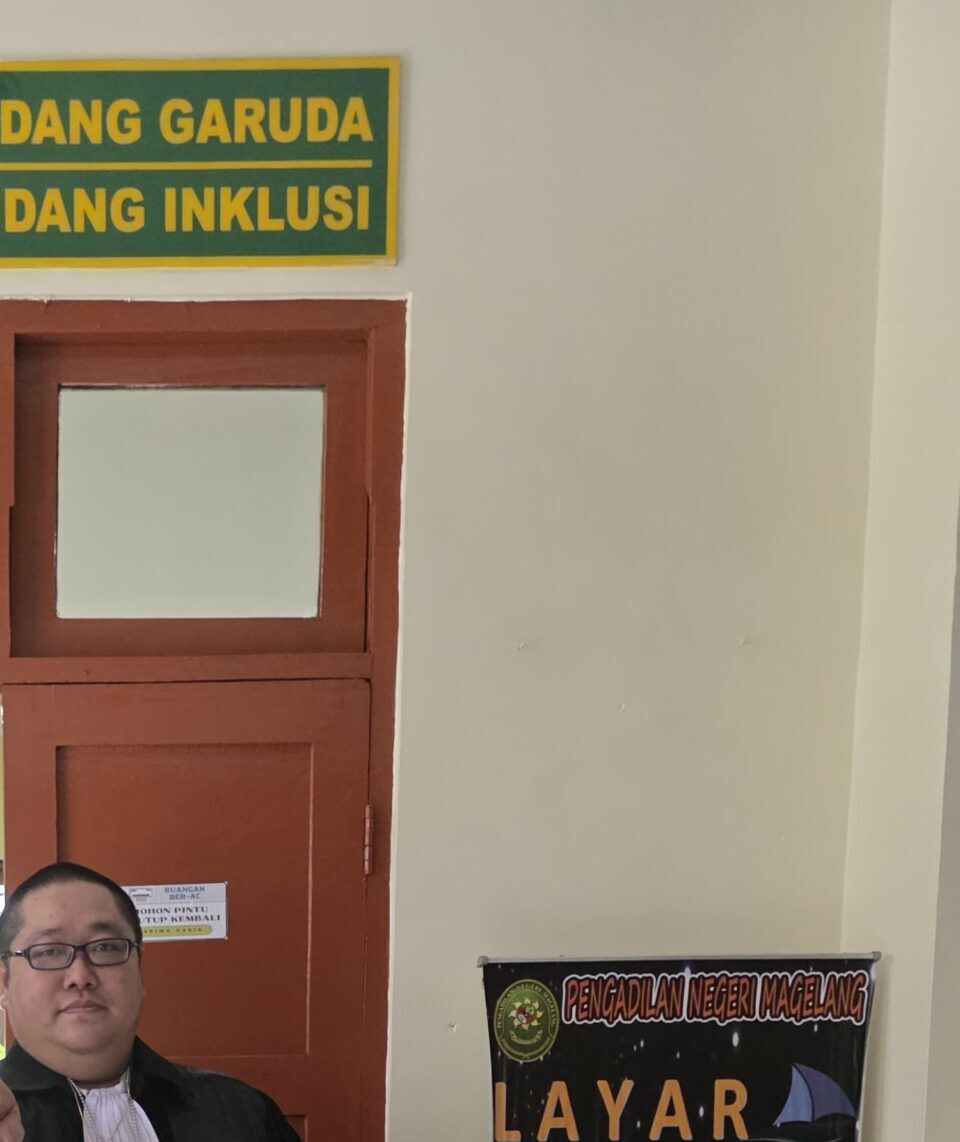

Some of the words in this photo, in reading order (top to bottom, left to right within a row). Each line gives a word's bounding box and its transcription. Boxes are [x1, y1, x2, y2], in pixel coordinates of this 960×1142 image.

[159, 96, 373, 145] GARUDA
[166, 186, 370, 232] INKLUSI
[164, 886, 206, 894] RUANGAN
[137, 907, 170, 915] OHON
[174, 906, 208, 914] PINTU
[171, 914, 220, 923] KEMBALI
[564, 974, 686, 1025] PENGADILAN
[688, 973, 758, 1024] NEGERI
[760, 972, 868, 1025] MAGELANG
